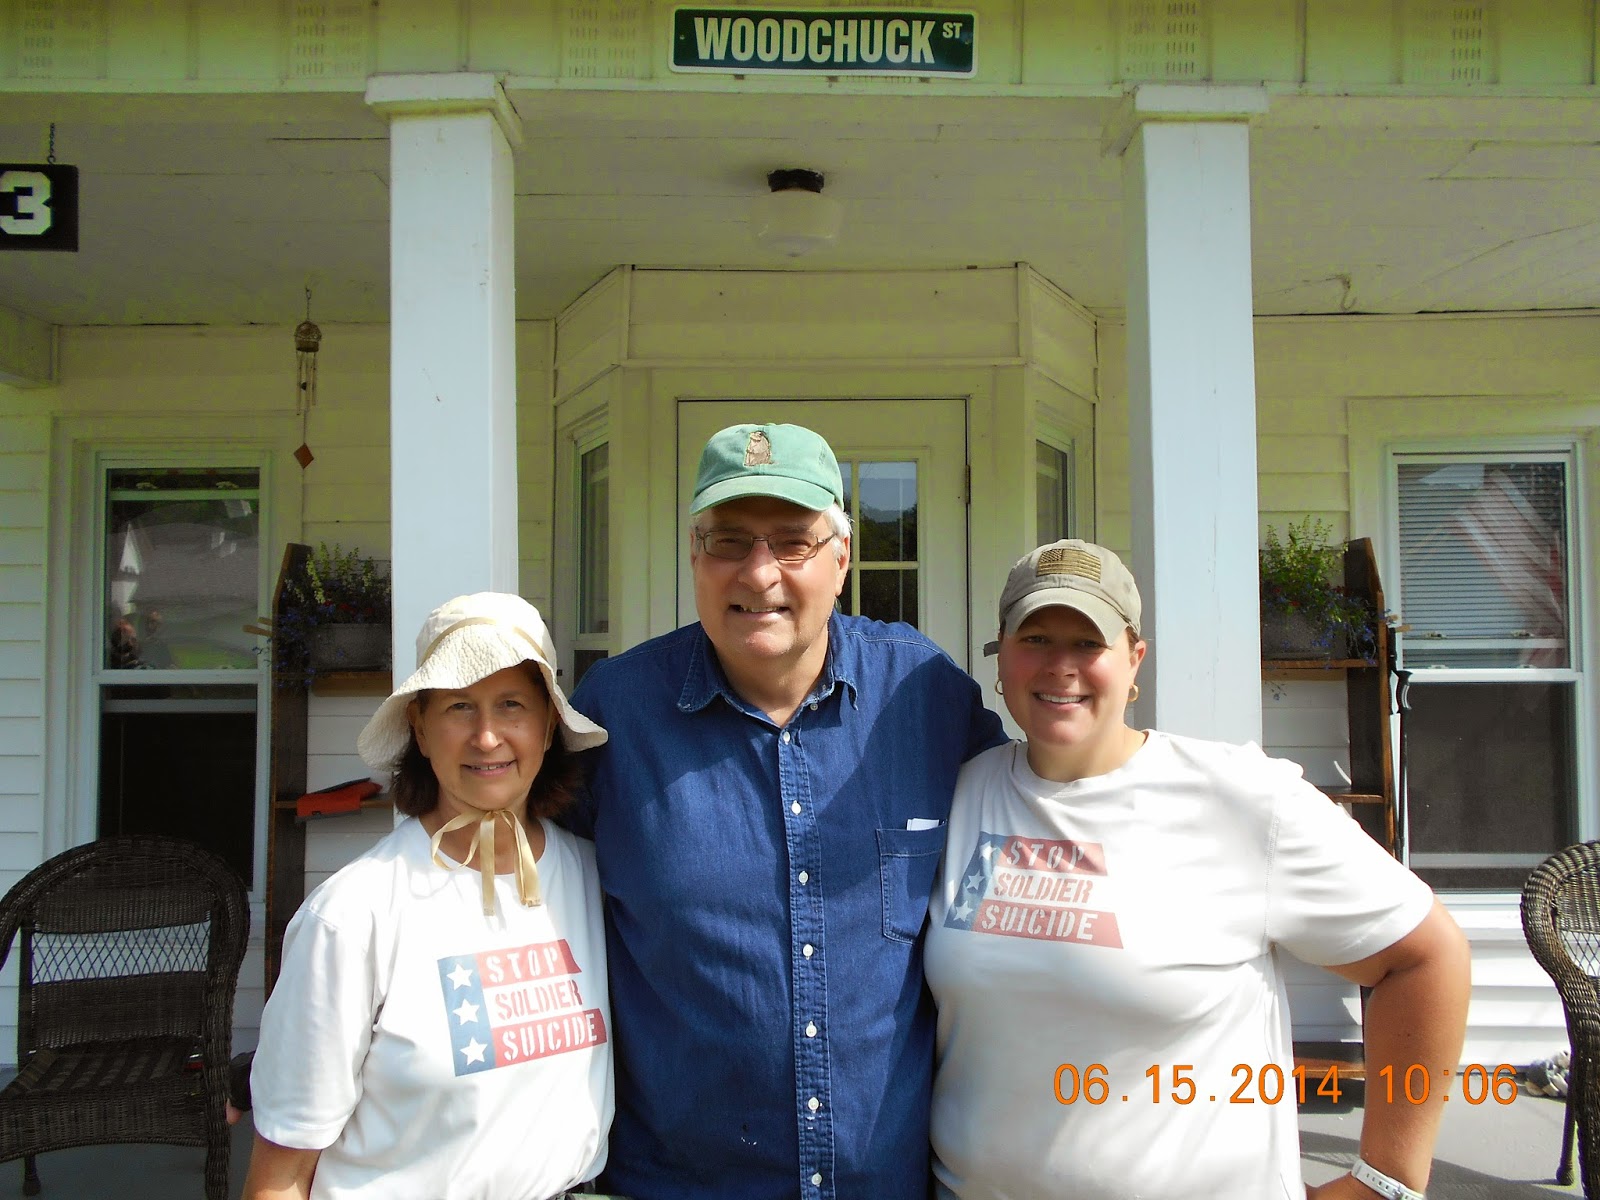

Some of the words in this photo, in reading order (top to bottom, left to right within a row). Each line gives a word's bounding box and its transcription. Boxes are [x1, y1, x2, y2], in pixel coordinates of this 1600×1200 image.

[694, 17, 935, 64] WOODCHUCK
[942, 22, 962, 39] ST
[0, 170, 51, 235] 3
[1006, 841, 1085, 870] STOP
[993, 872, 1094, 904] SOLDIER
[981, 904, 1098, 941] SUICIDE
[485, 946, 558, 984] STOP
[494, 979, 583, 1021] SOLDIER
[502, 1013, 598, 1061] SUICIDE
